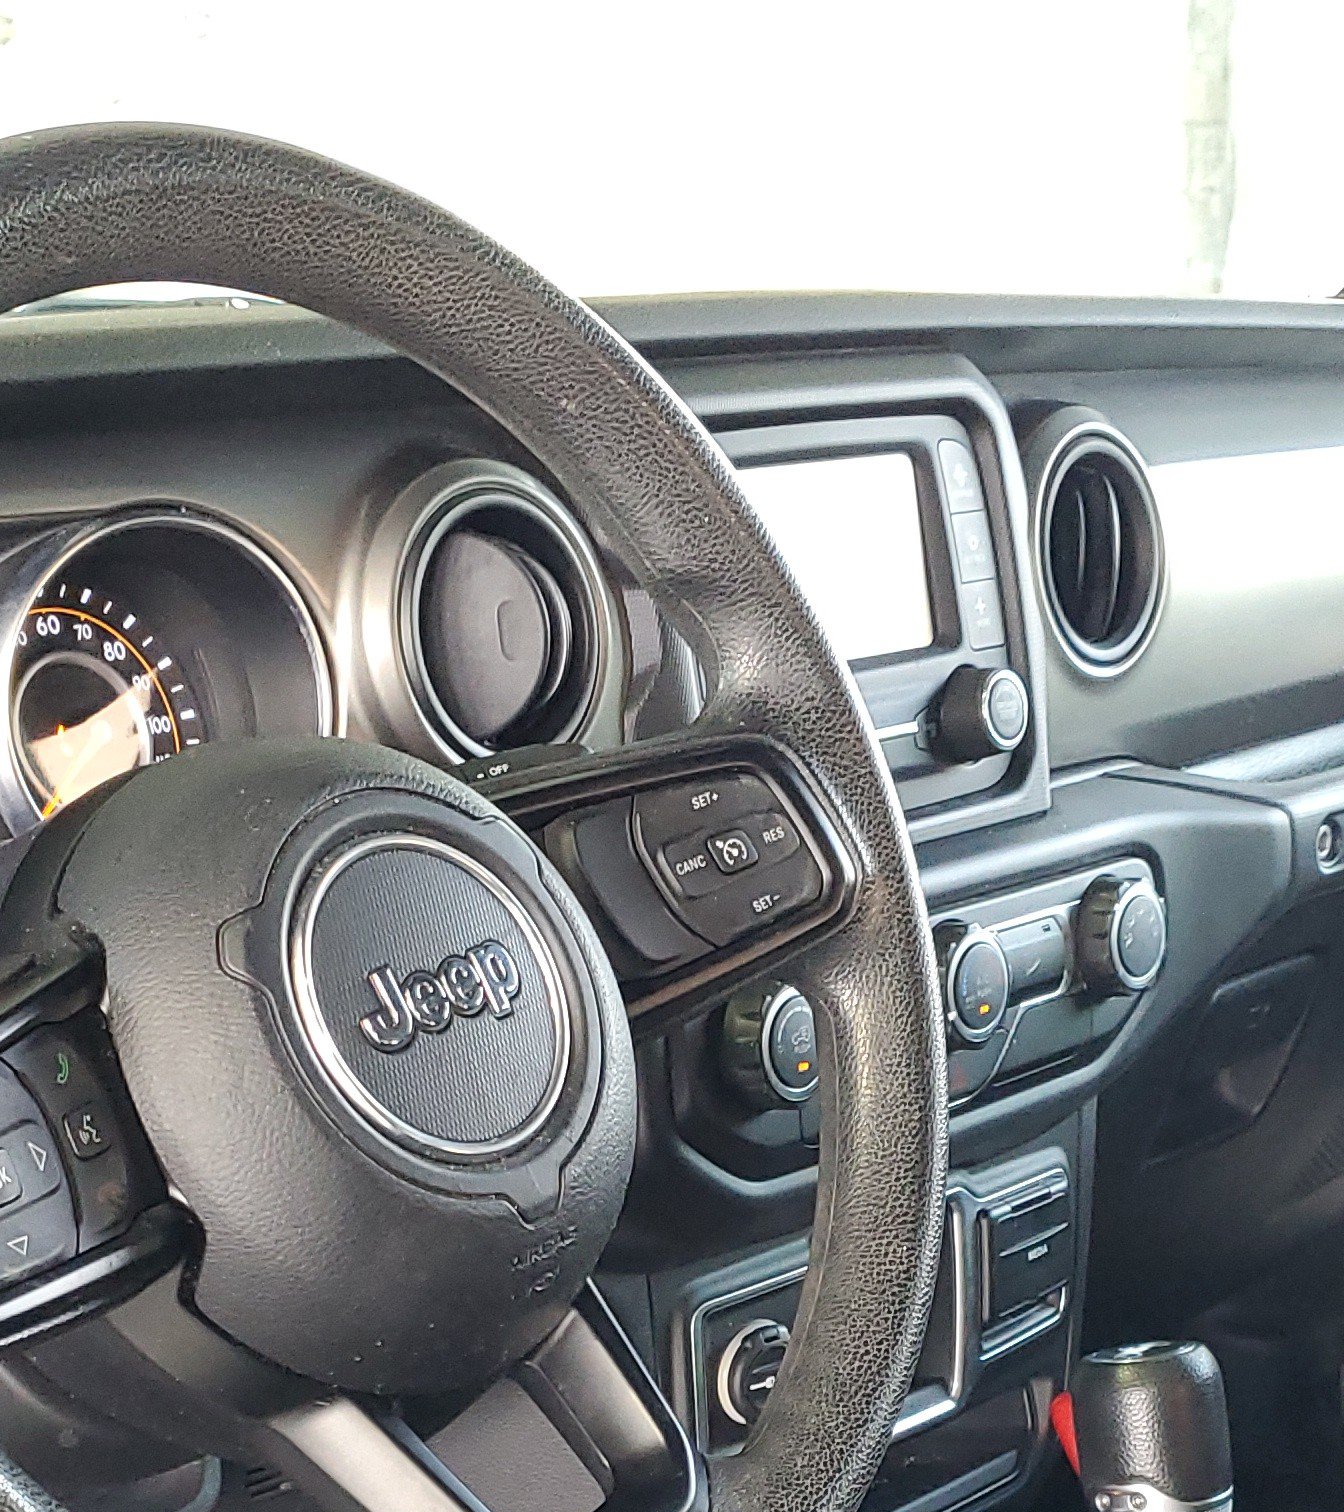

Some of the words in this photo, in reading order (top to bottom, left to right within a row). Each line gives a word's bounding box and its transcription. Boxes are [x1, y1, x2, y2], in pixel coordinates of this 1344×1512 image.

[35, 614, 61, 637] 60
[72, 623, 93, 642] 70
[102, 641, 127, 662] 80
[131, 674, 151, 692] 90
[147, 714, 172, 735] 100
[488, 763, 510, 777] OFF
[761, 825, 786, 845] RES
[675, 853, 708, 877] CANC
[358, 939, 521, 1052] Jeep
